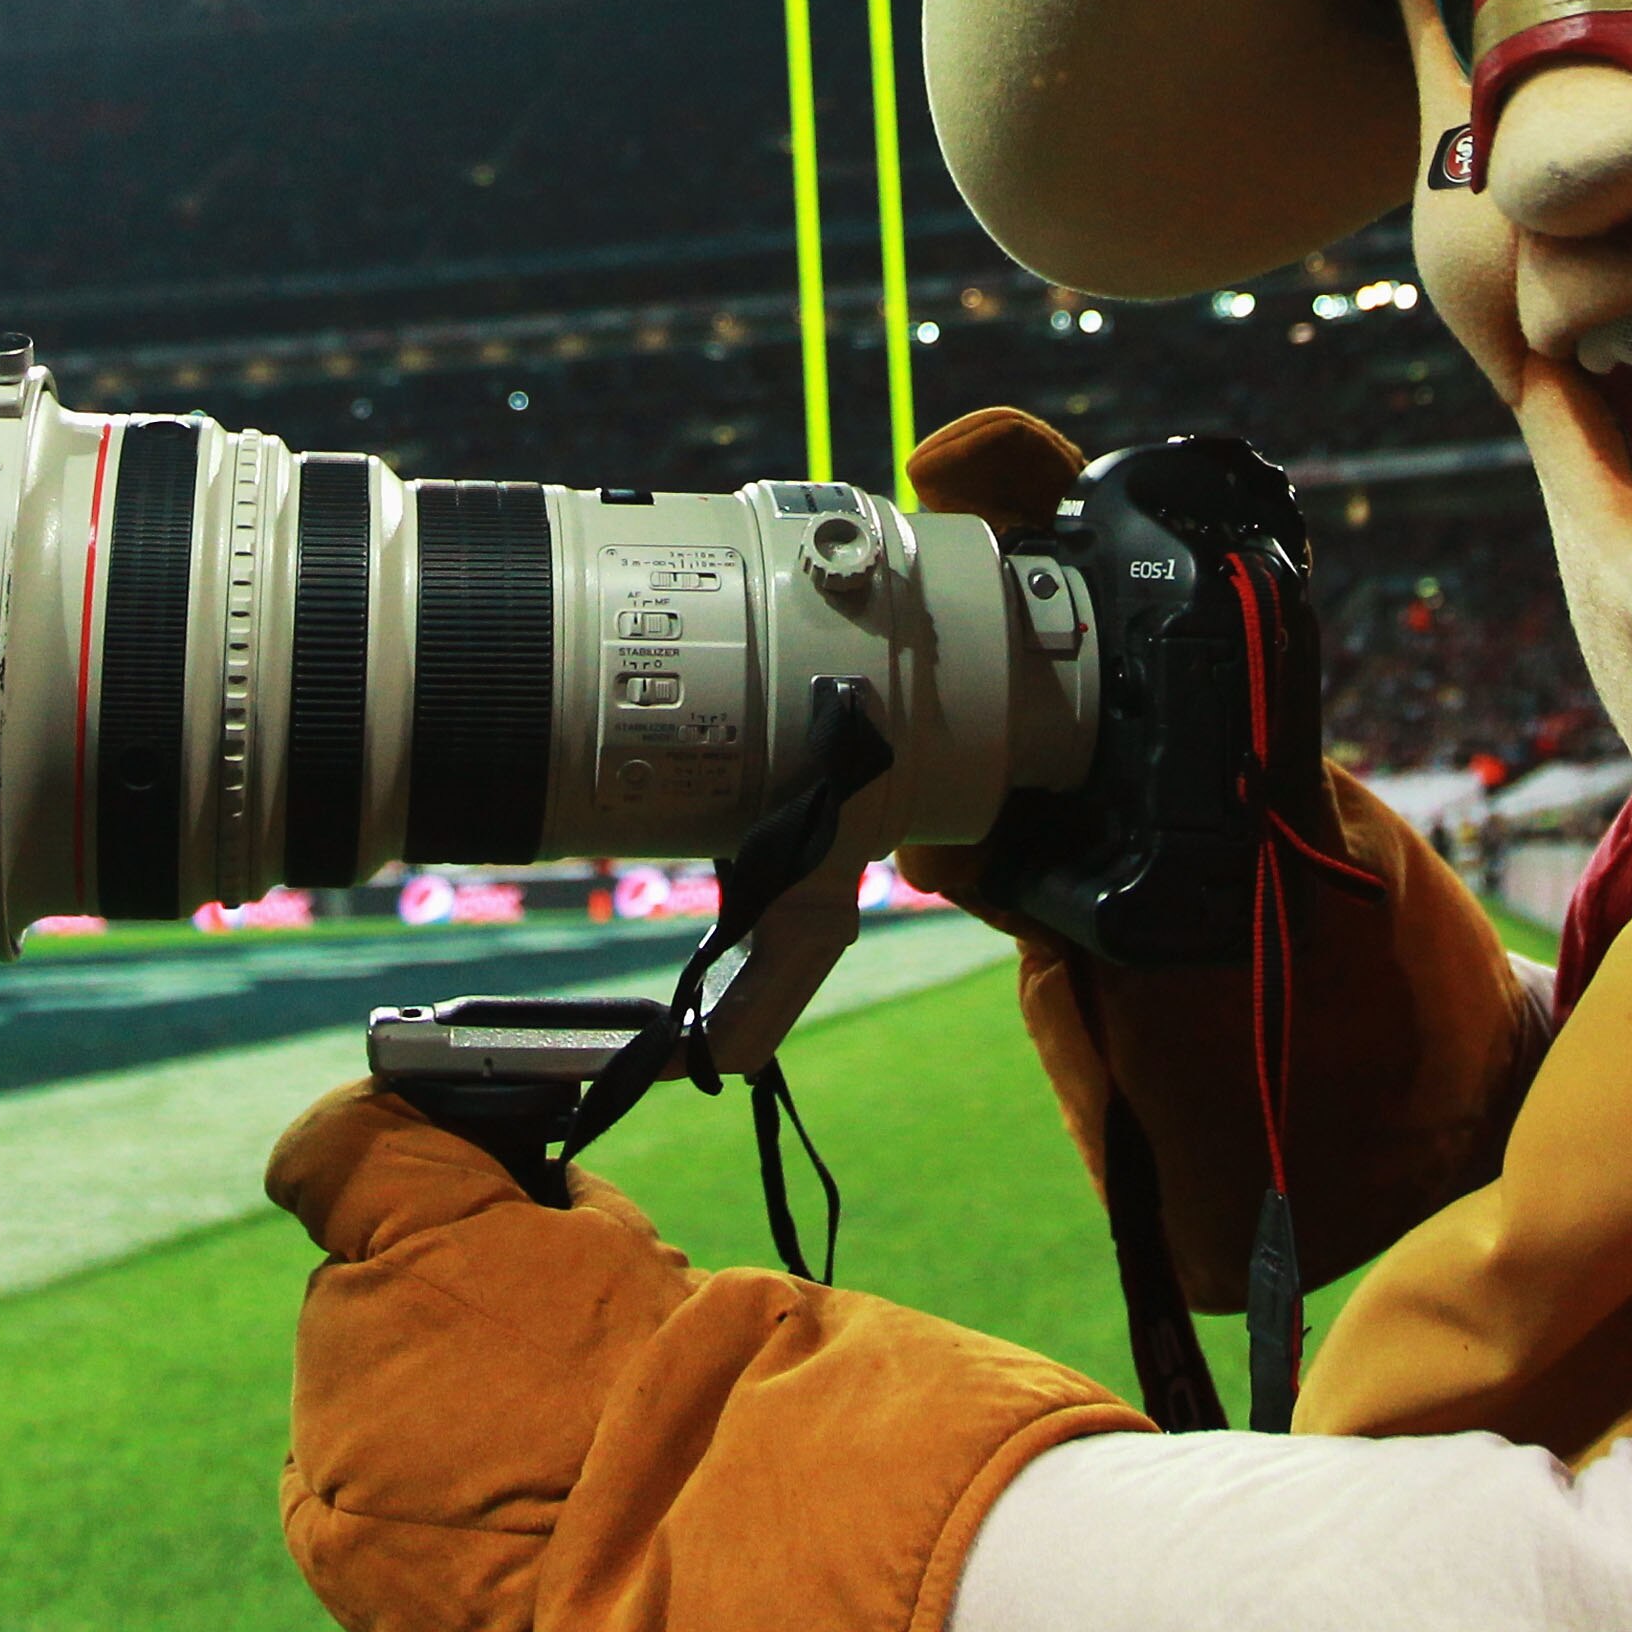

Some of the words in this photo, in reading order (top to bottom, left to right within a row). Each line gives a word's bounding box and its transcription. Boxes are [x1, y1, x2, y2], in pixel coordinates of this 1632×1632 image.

[1130, 559, 1176, 580] EOS-1
[627, 591, 641, 599] AF
[654, 598, 670, 606] MF
[618, 647, 680, 657] STABILIZER
